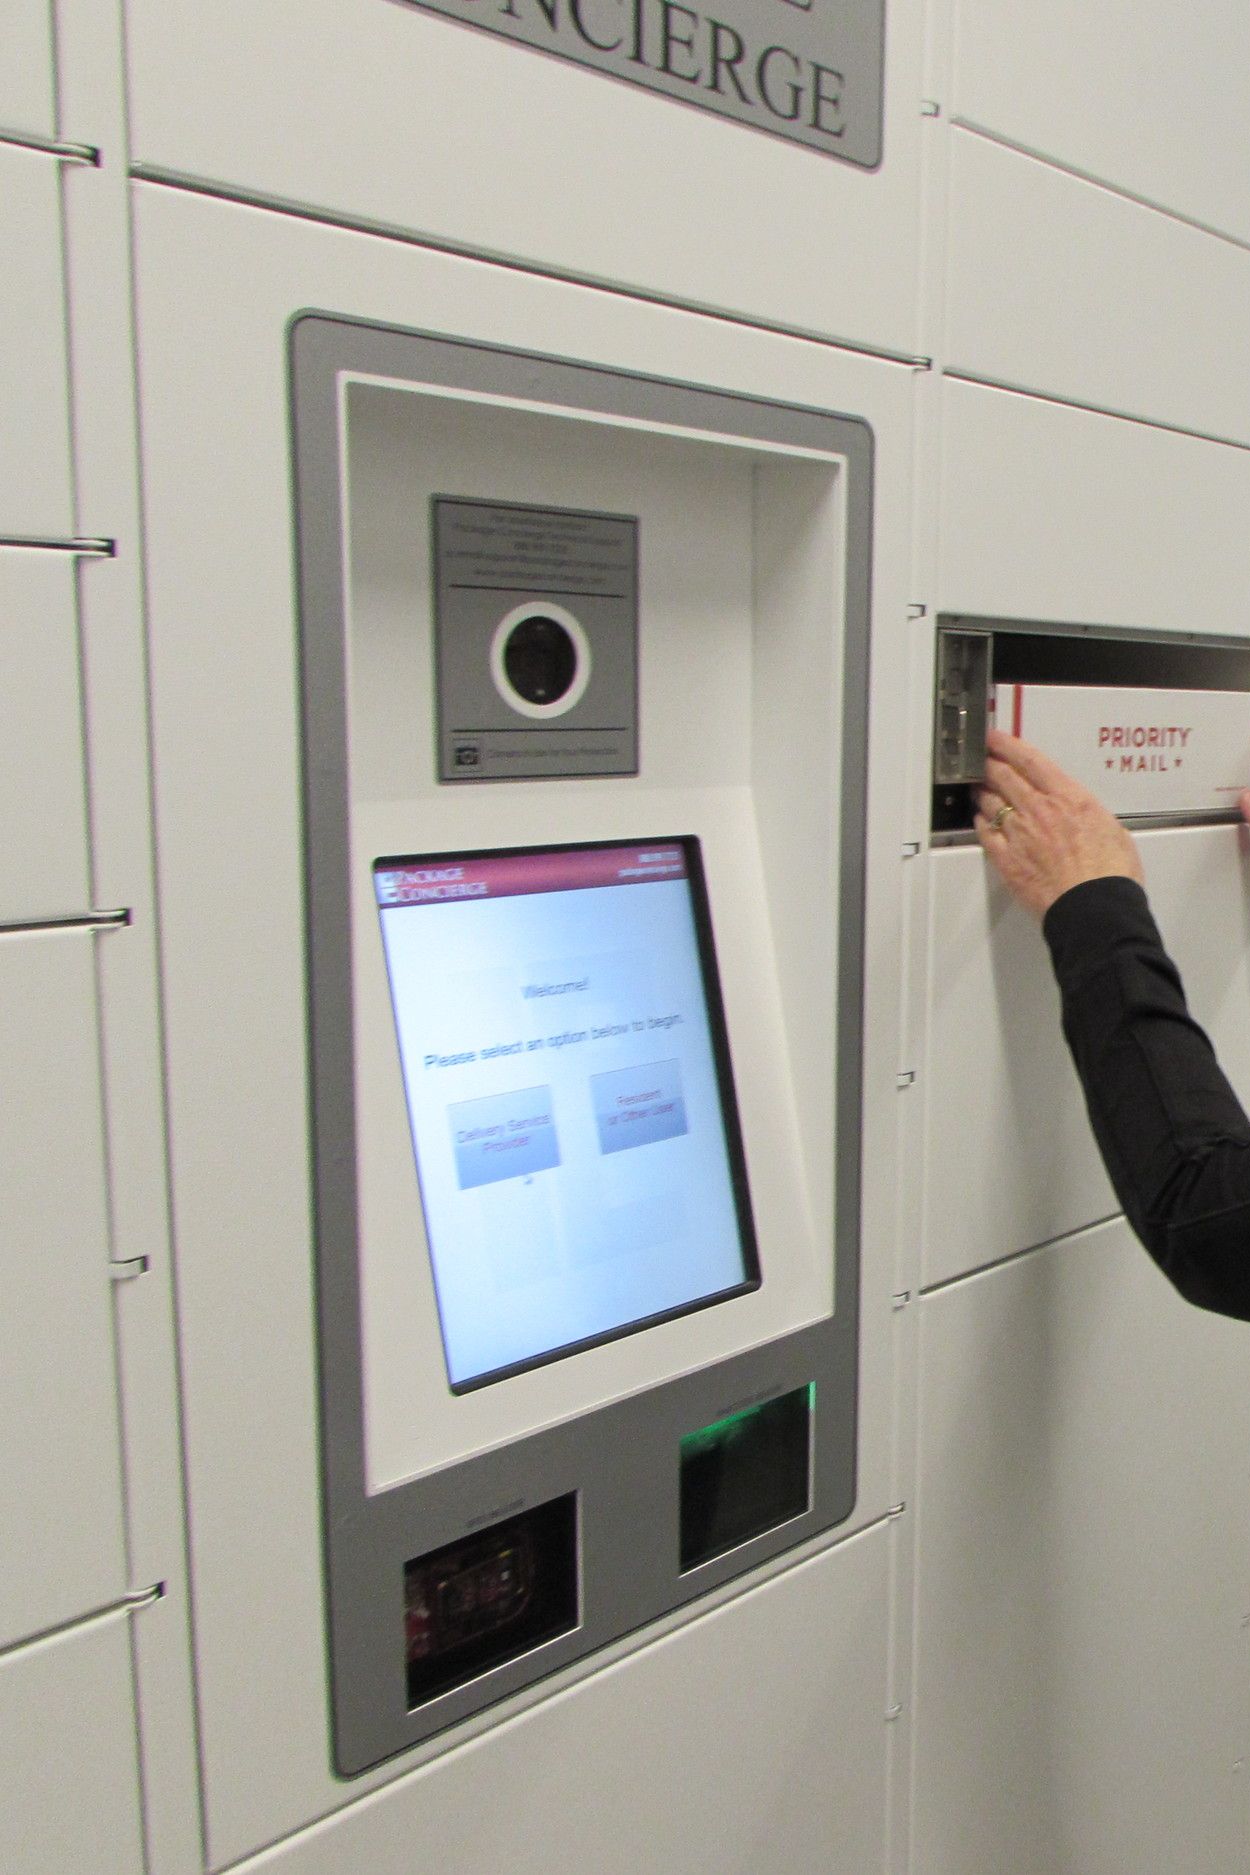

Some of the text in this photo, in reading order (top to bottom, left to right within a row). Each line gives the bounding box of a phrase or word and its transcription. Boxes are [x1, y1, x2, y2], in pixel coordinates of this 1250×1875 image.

[1099, 727, 1192, 748] PRIORITY
[1120, 754, 1168, 773] MAIL
[424, 1050, 477, 1069] Please
[480, 1041, 523, 1060] select
[526, 1038, 546, 1051] an
[547, 1030, 588, 1049] option
[590, 1022, 630, 1040] below
[631, 1019, 645, 1032] to
[456, 1113, 552, 1145] Delivery Service
[483, 1135, 531, 1152] Provider
